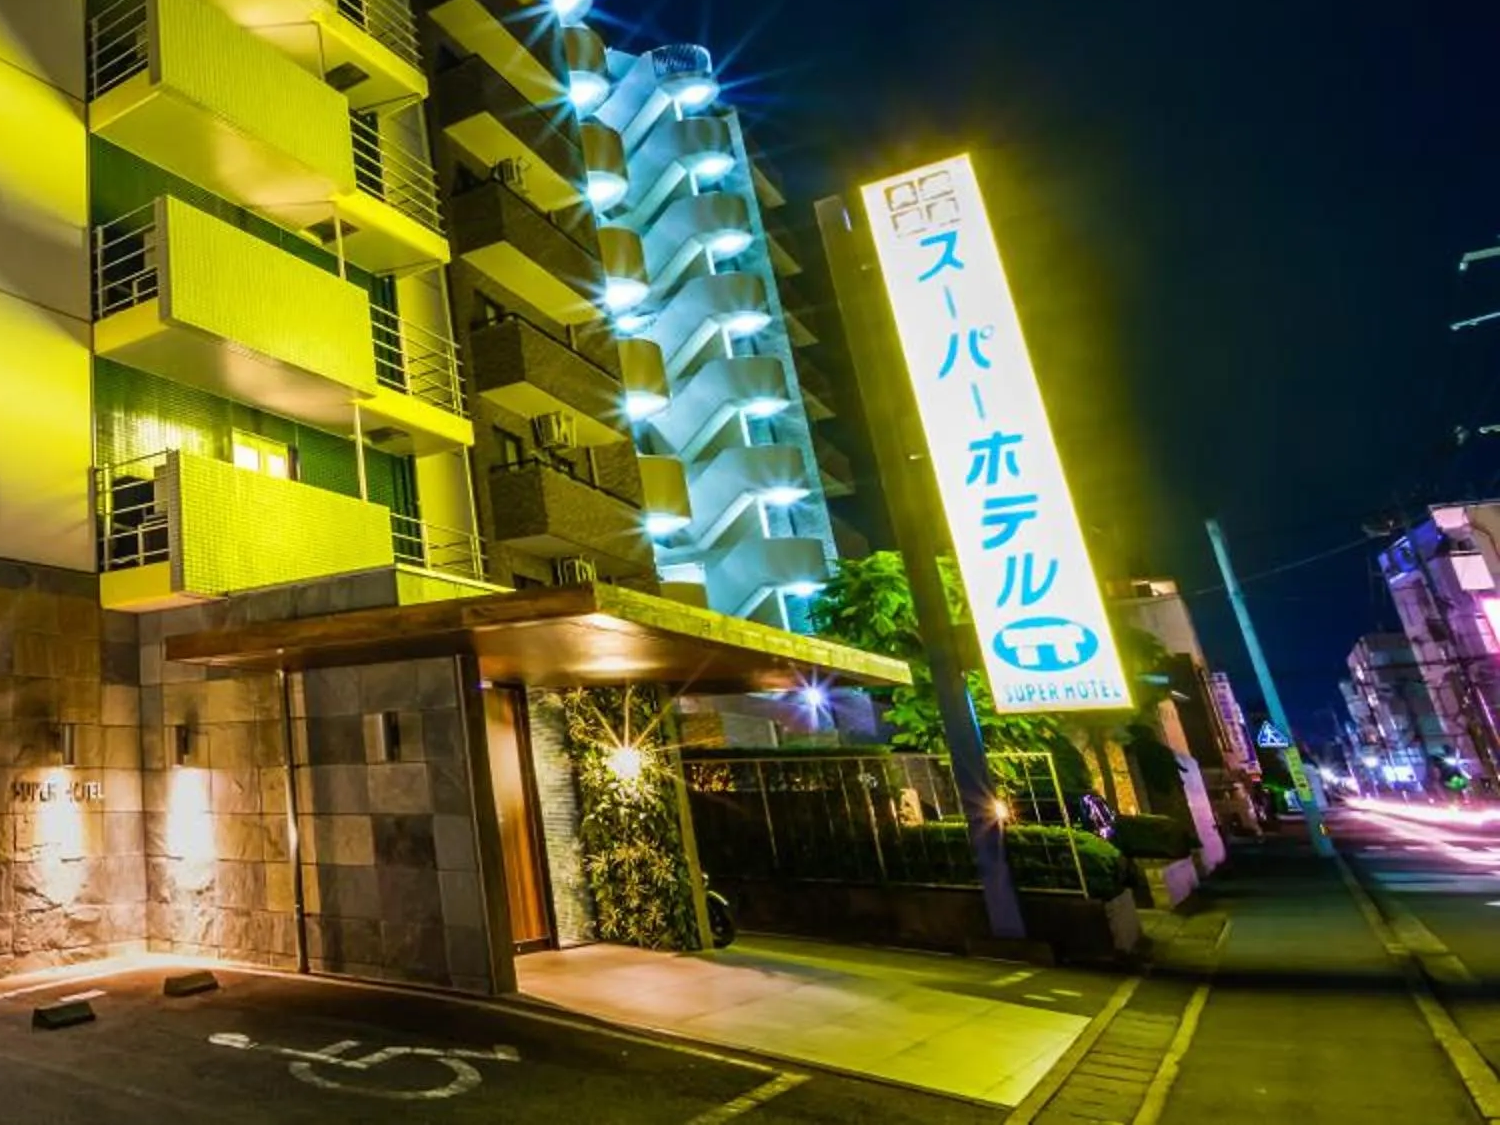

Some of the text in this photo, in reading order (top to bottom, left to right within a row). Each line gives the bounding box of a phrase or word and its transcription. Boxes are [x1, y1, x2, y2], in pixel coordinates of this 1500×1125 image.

[916, 229, 1059, 608] スーパーホテル
[1004, 676, 1124, 704] SUPER HOTEL
